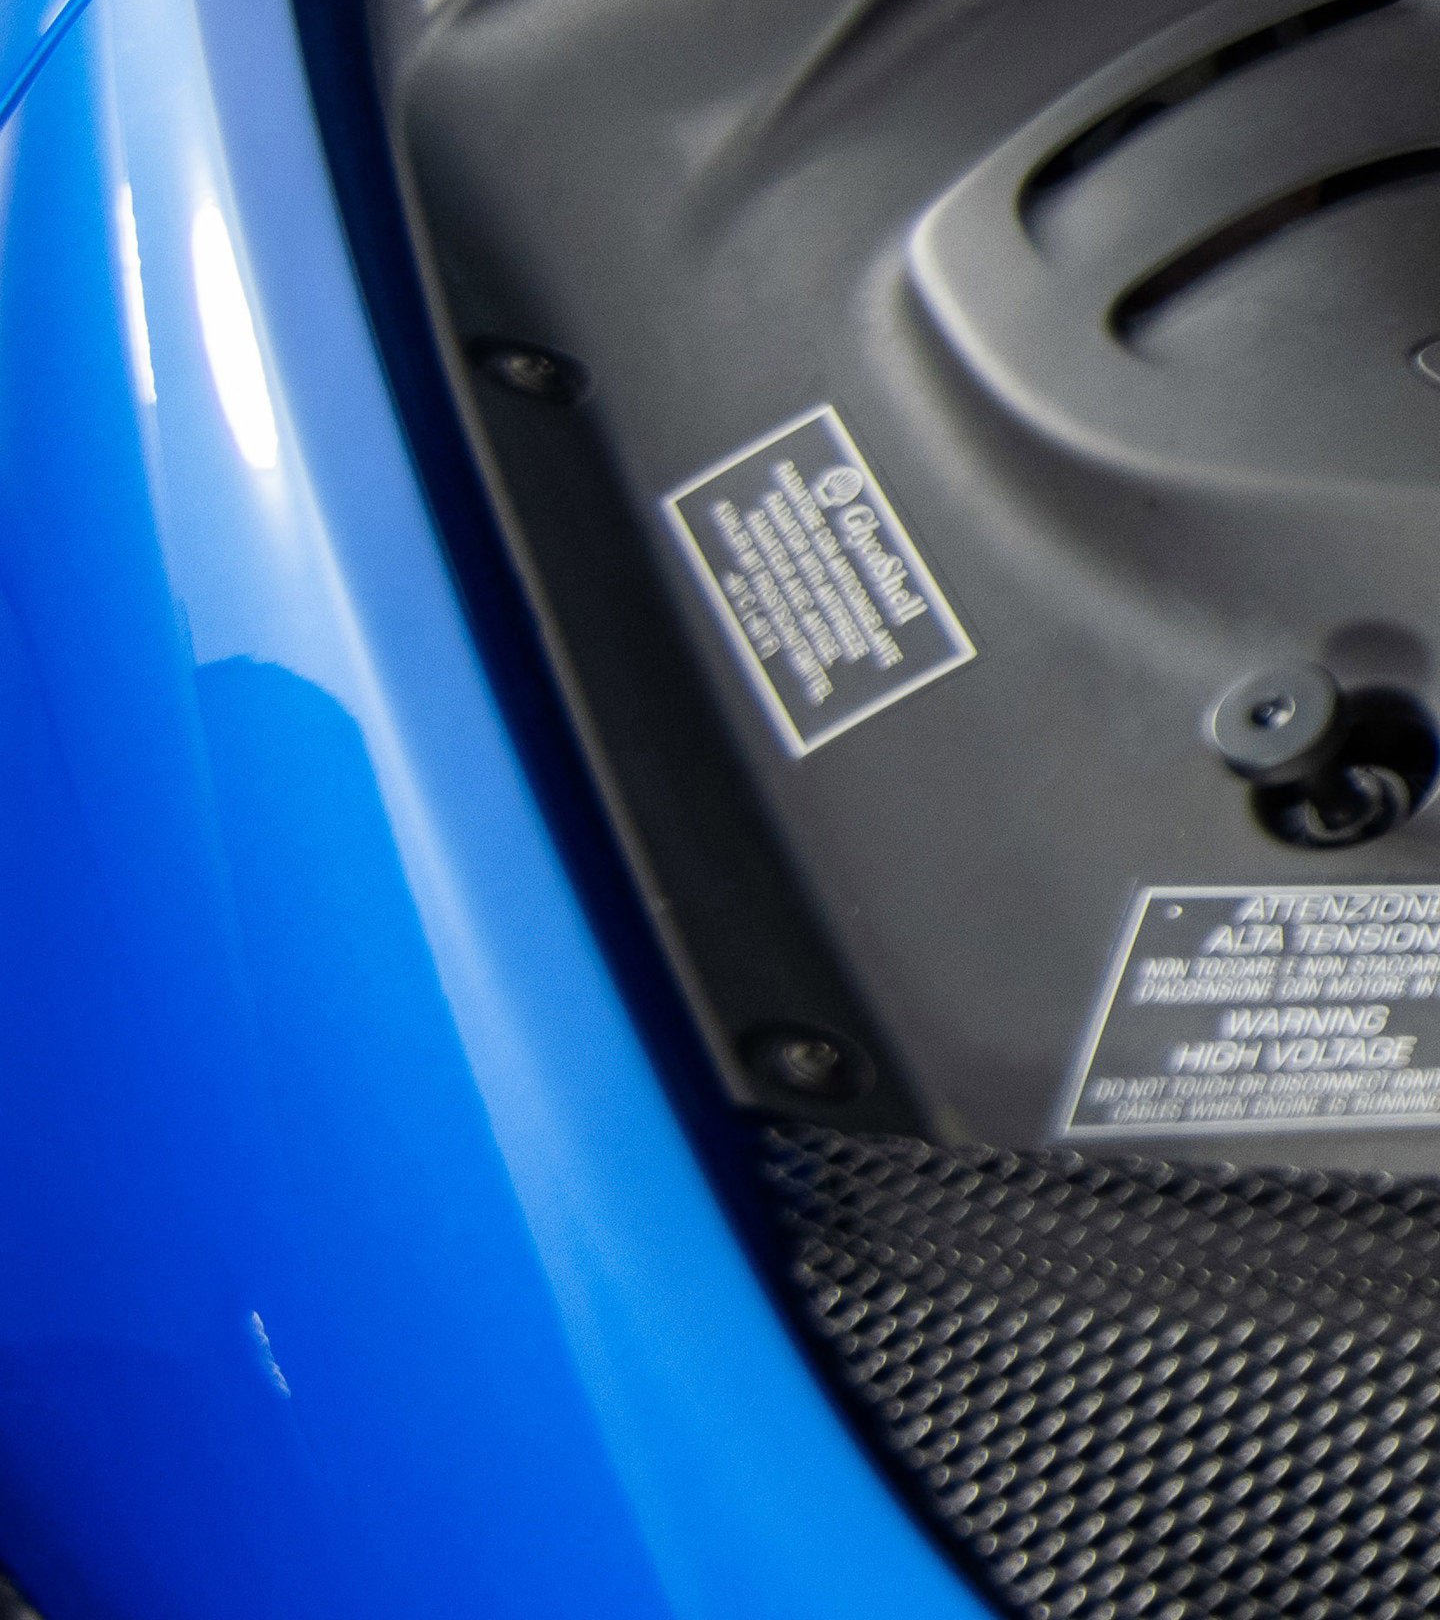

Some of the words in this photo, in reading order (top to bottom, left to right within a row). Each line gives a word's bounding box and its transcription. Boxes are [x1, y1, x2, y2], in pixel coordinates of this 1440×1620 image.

[1203, 924, 1289, 954] ALTA
[1218, 1006, 1390, 1037] WARNING
[1167, 1040, 1262, 1073] HIGH
[1260, 1036, 1417, 1070] VOLTAGE
